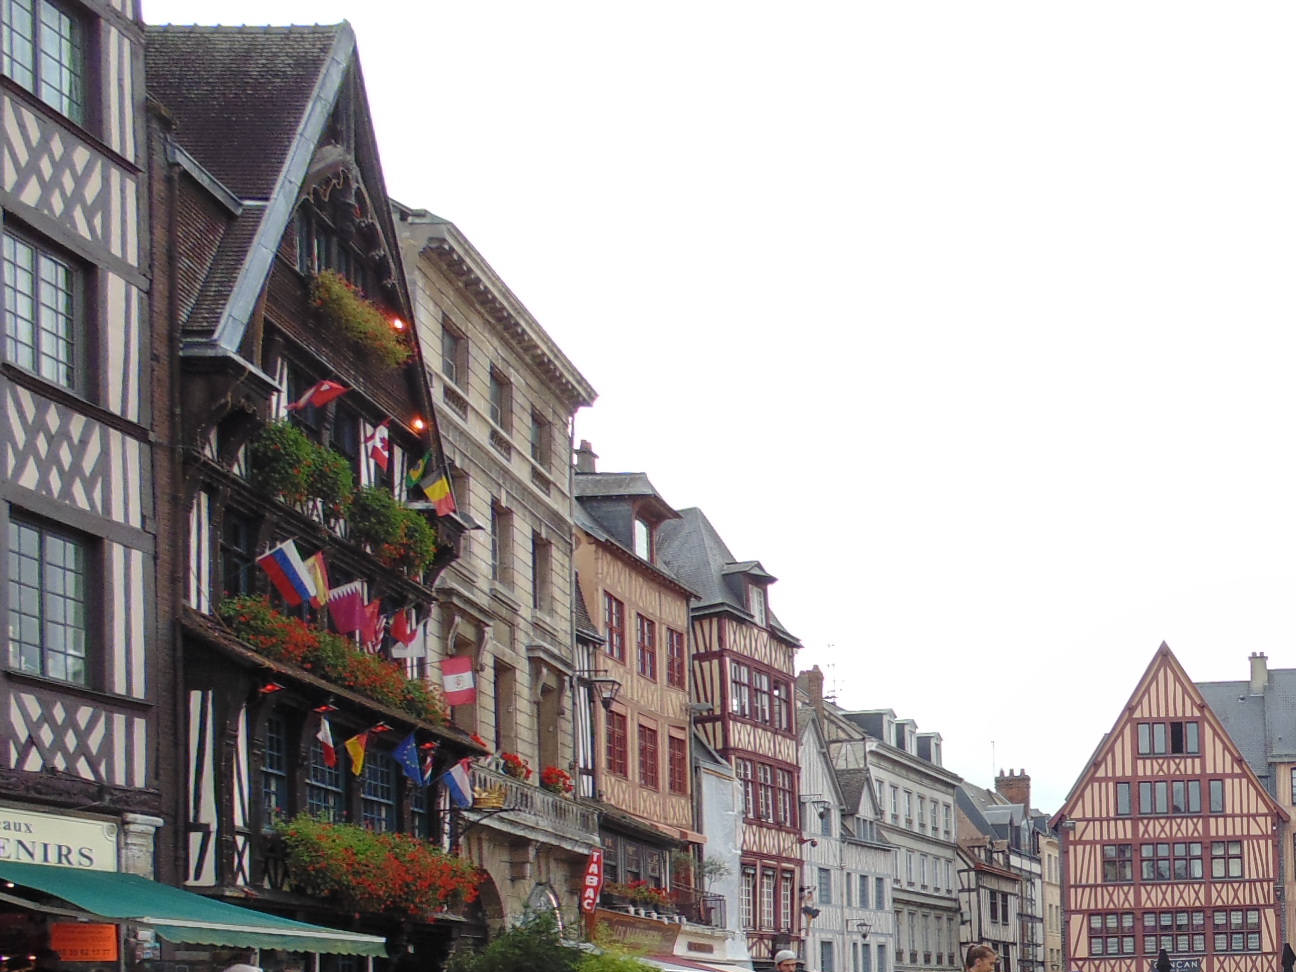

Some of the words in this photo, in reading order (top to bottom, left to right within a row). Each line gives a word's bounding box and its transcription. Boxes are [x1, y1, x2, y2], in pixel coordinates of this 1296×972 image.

[0, 820, 33, 834] aux
[583, 851, 600, 910] TABAC
[1153, 960, 1198, 969] CNCAN
